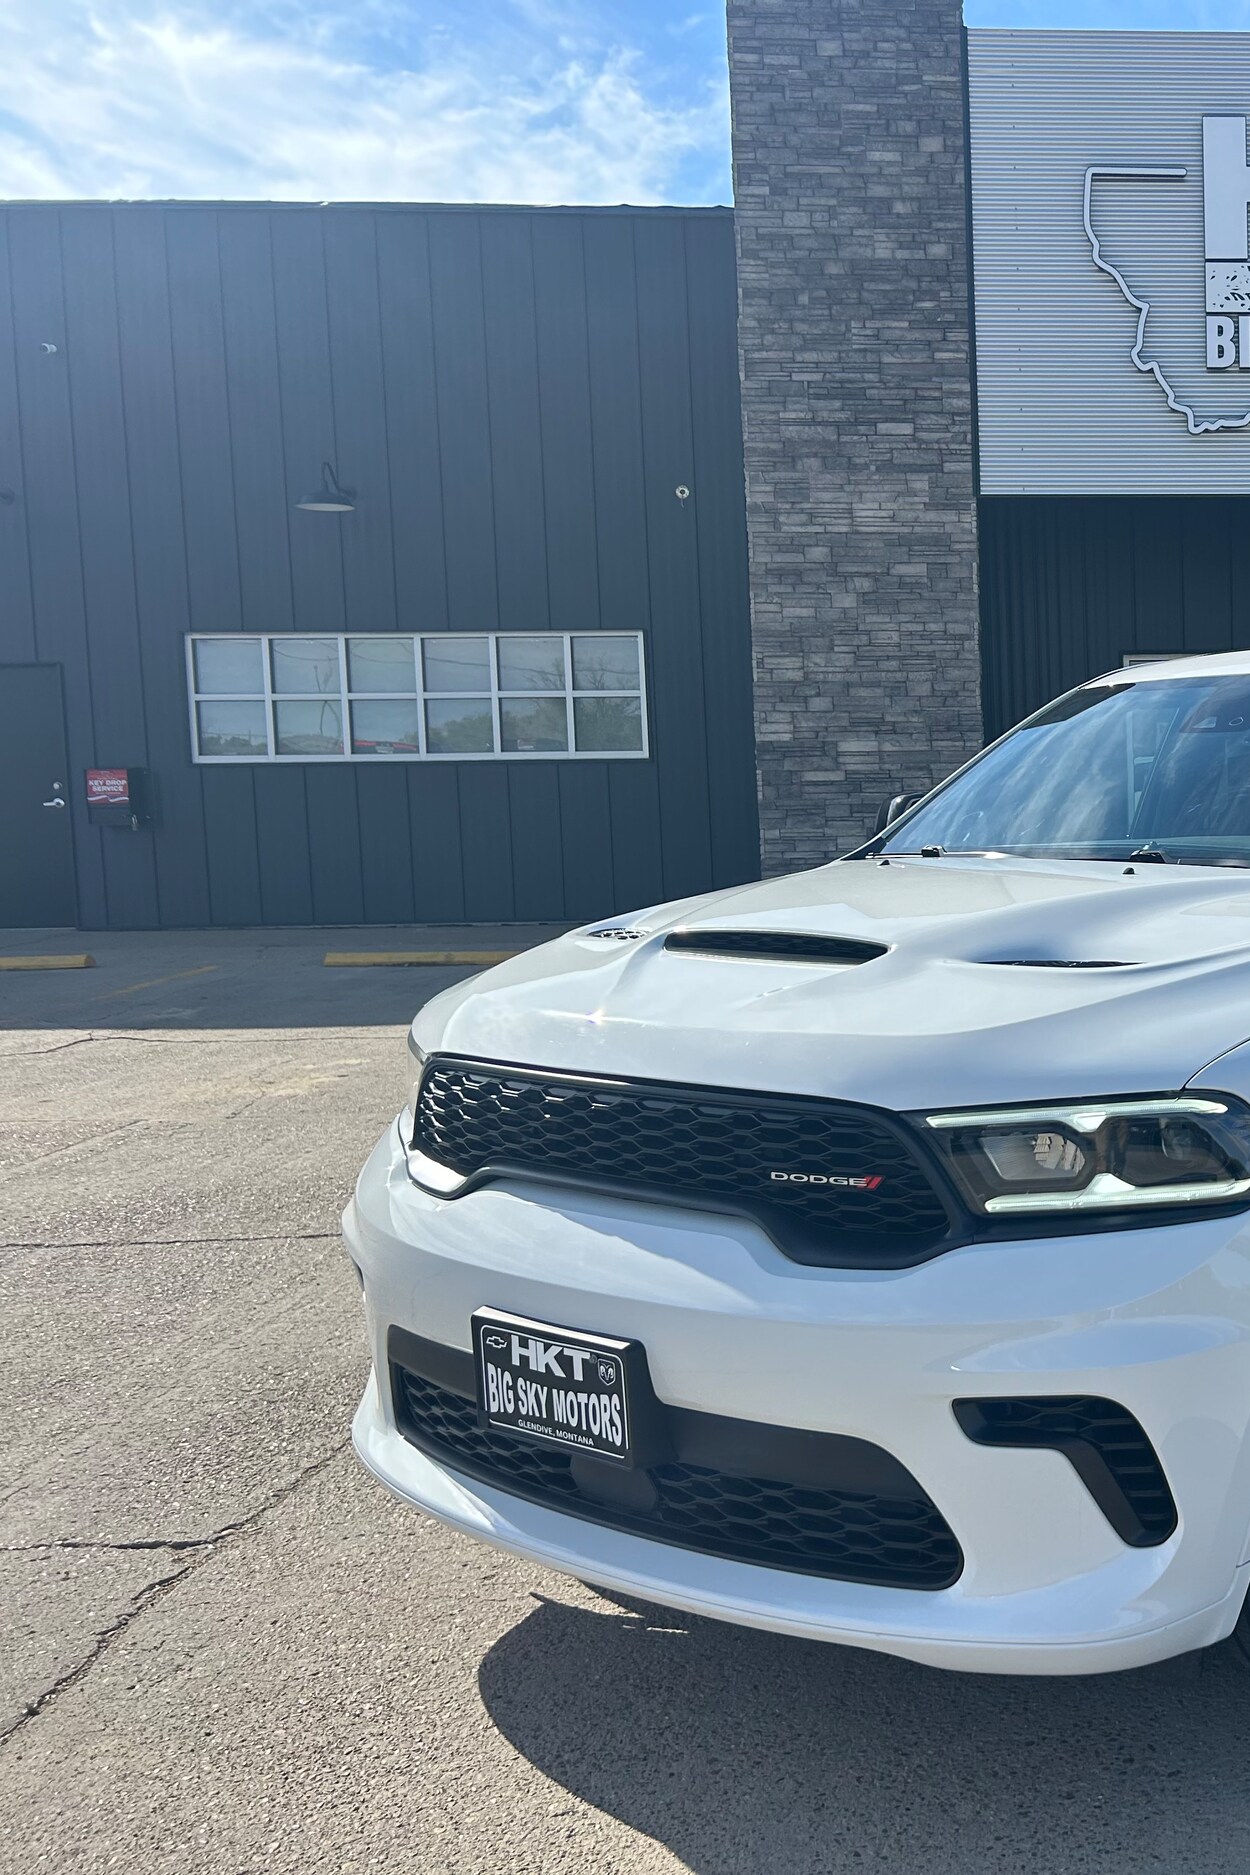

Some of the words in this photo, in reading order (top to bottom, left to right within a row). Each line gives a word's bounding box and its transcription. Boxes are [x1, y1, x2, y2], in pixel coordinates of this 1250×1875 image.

[770, 1171, 868, 1187] DODGE
[510, 1334, 591, 1382] HKT
[487, 1362, 515, 1414] BIG
[517, 1376, 548, 1420] SKY
[552, 1388, 623, 1447] MOTORS
[556, 1429, 595, 1447] MONTANA
